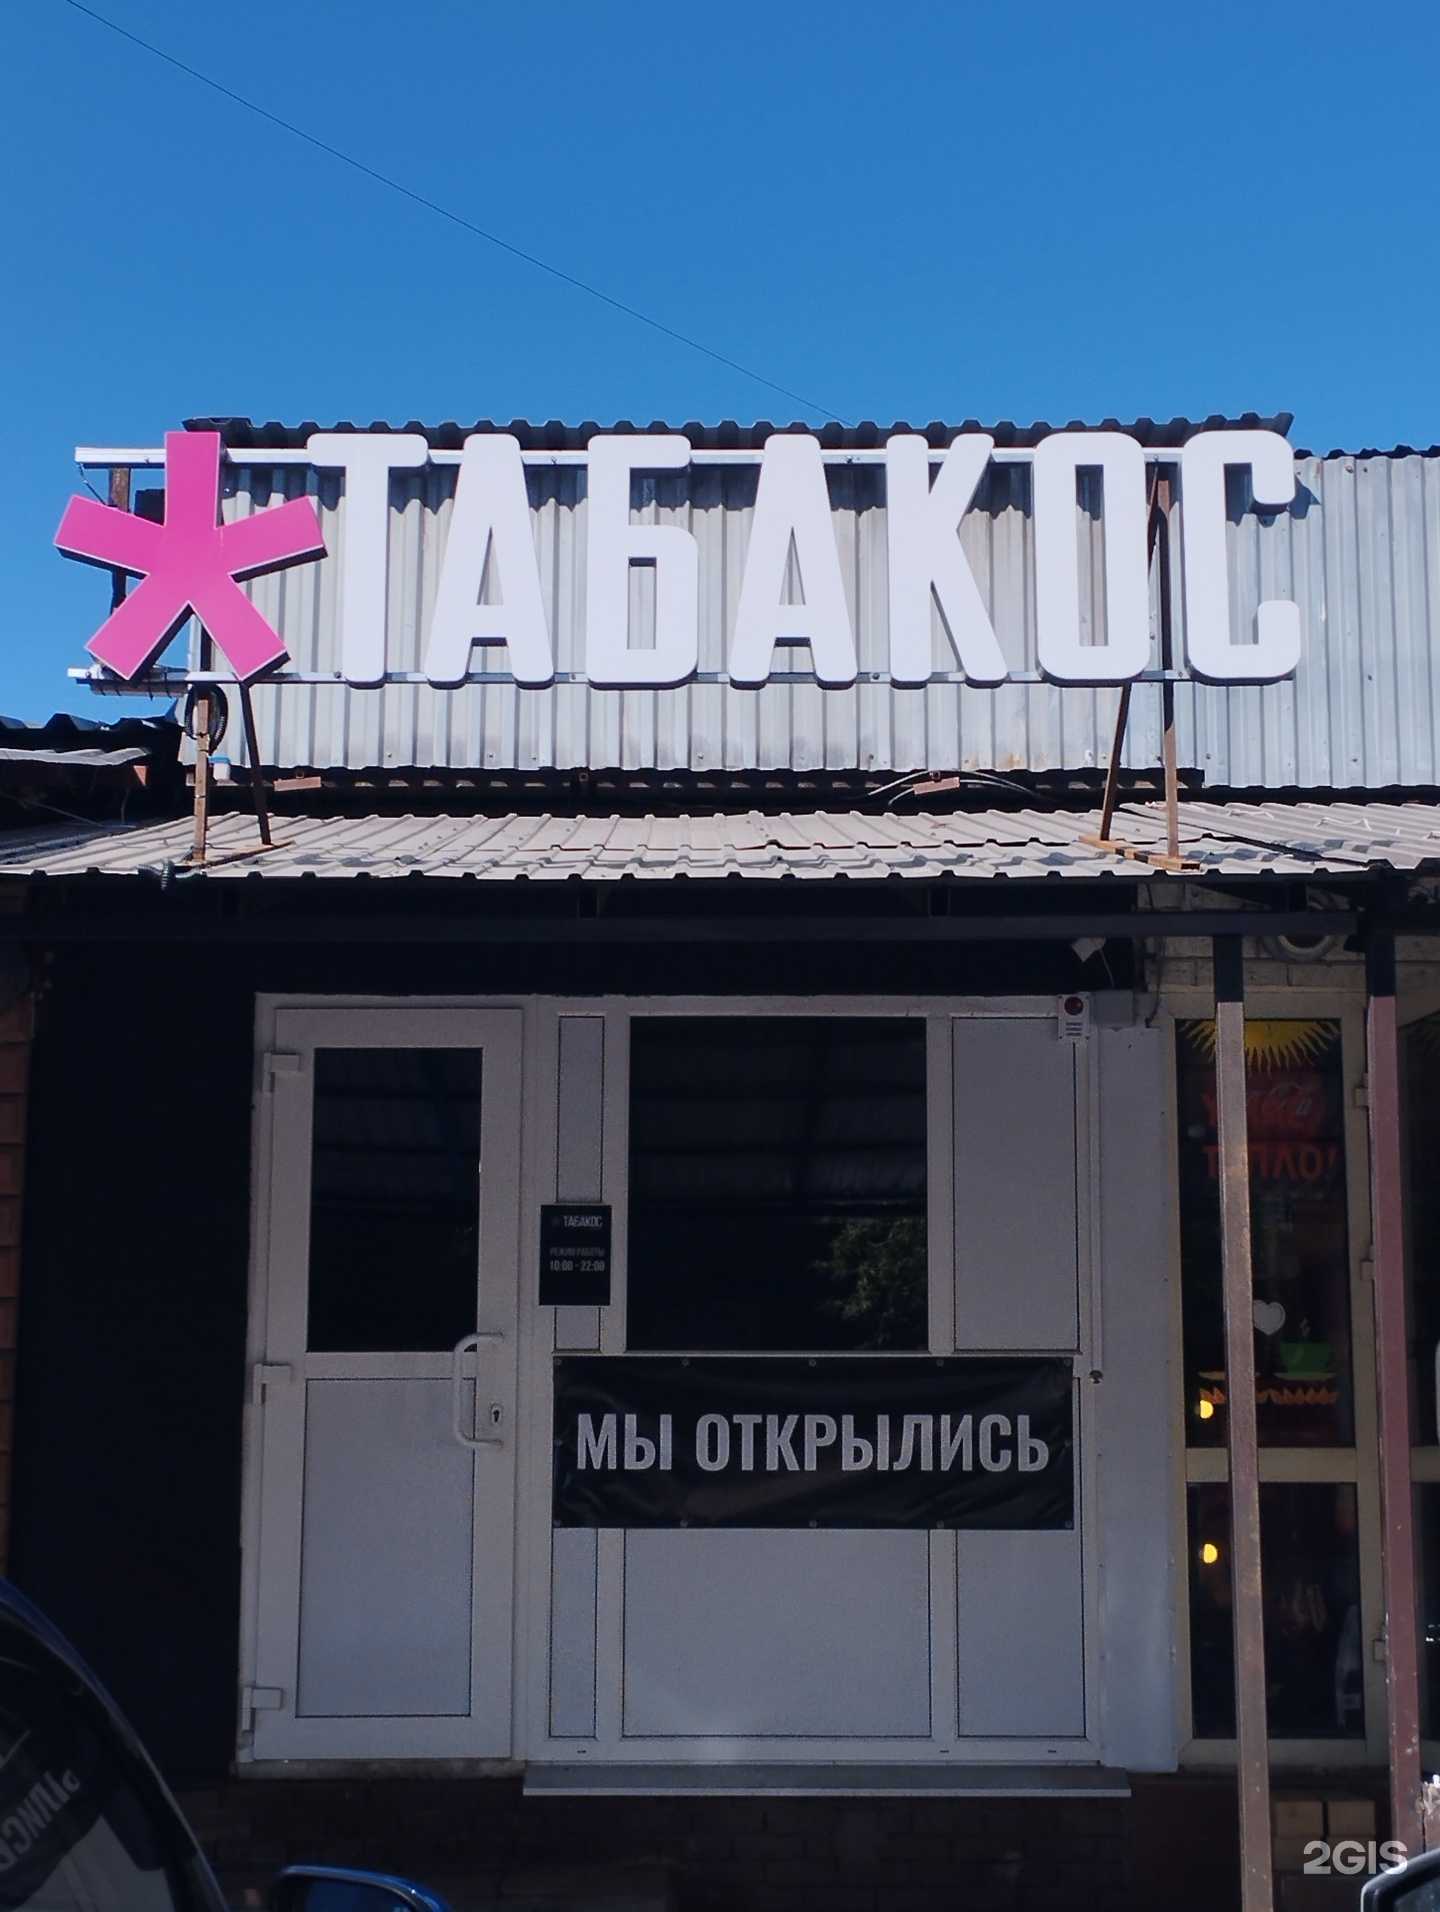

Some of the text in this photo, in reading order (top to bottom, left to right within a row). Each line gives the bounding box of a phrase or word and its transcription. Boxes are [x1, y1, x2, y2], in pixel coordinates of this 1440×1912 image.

[306, 429, 1301, 690] ТАБАКОС
[562, 1215, 604, 1229] ТАБАКОС
[576, 1413, 1050, 1472] МЫ ОТКРЫЛИСЬ
